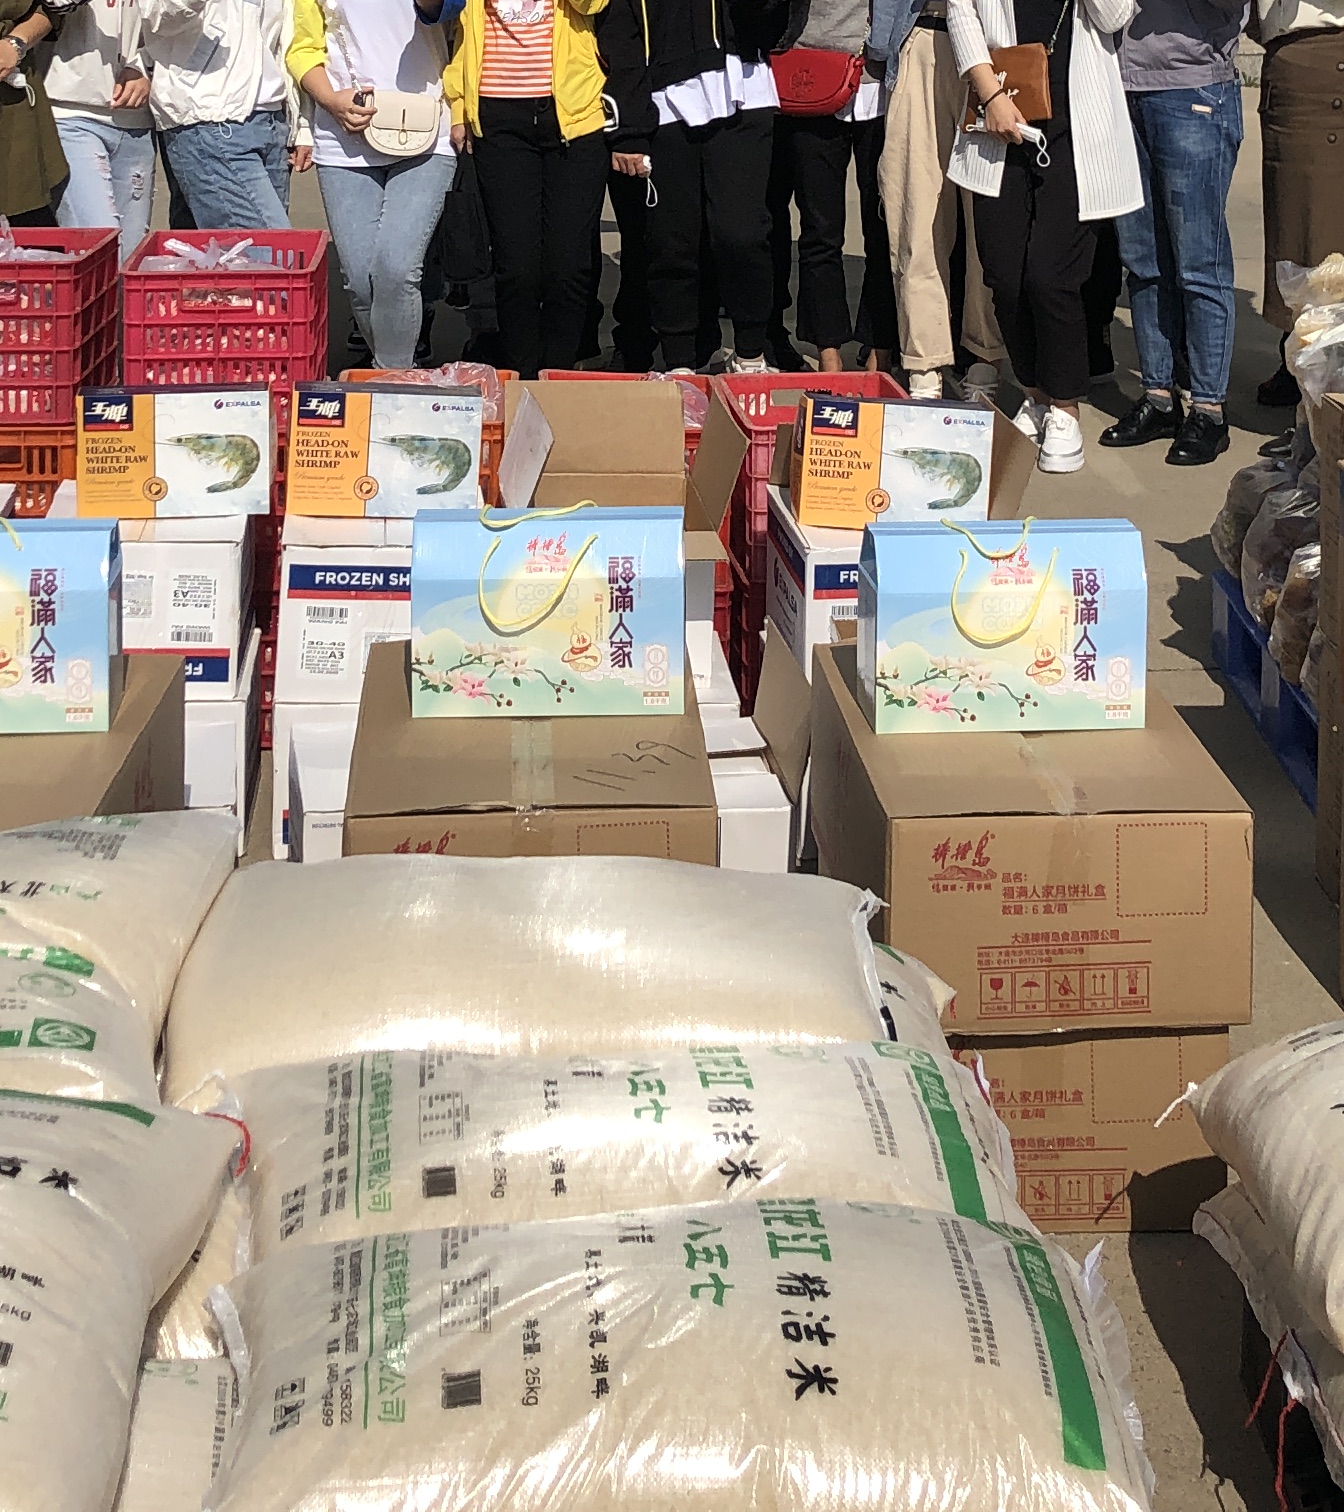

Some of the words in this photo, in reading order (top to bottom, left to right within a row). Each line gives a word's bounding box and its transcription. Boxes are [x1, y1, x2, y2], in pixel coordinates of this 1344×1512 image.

[296, 430, 331, 438] FROZEN
[85, 437, 123, 445] FROZEN
[296, 438, 350, 449] HEAD-ON
[809, 438, 845, 448] FROZEN
[86, 445, 136, 455] HEAD-ON
[296, 448, 334, 459] WHITE
[334, 449, 361, 460] RAW
[809, 447, 863, 460] HEAD-ON
[86, 455, 123, 465] WHITE
[124, 455, 149, 464] RAW
[294, 459, 341, 470] SHRIMP
[809, 457, 846, 469] WHITE
[846, 460, 874, 471] RAW
[85, 465, 130, 475] SHRIMP
[807, 468, 854, 480] SHRIMP
[314, 571, 384, 586] FROZEN
[328, 650, 345, 660] A3
[774, 1268, 840, 1402] 精洁米
[520, 1365, 545, 1409] 25kg
